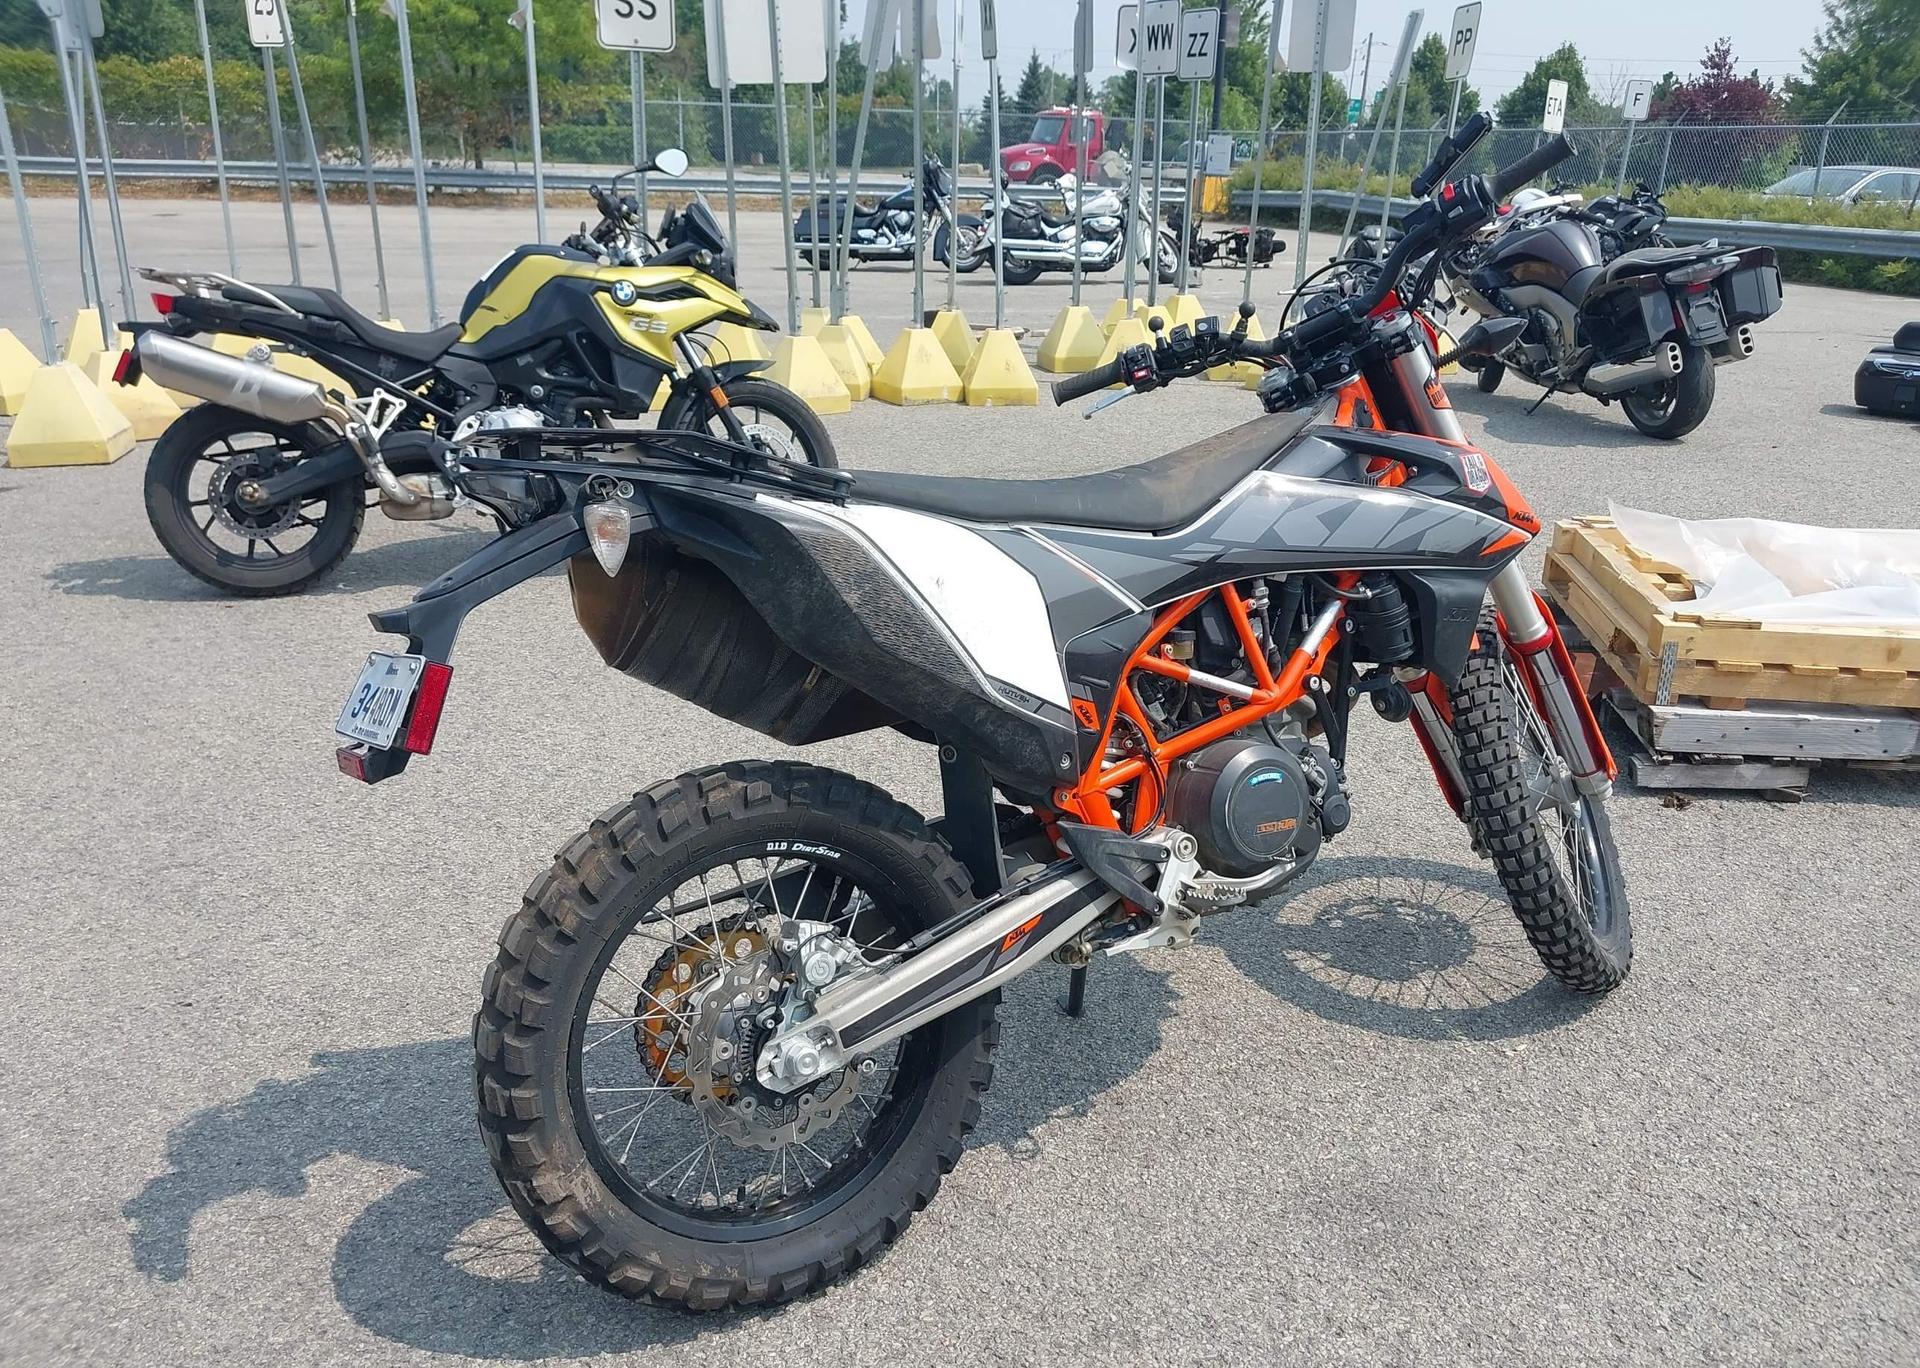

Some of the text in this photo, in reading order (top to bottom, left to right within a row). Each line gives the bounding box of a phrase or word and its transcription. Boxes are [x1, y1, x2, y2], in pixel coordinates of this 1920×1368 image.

[1147, 23, 1174, 52] WW
[1187, 32, 1209, 58] ZZ
[1453, 28, 1473, 56] PP
[1547, 97, 1562, 116] ETA
[1633, 92, 1644, 106] F
[629, 317, 669, 334] GS
